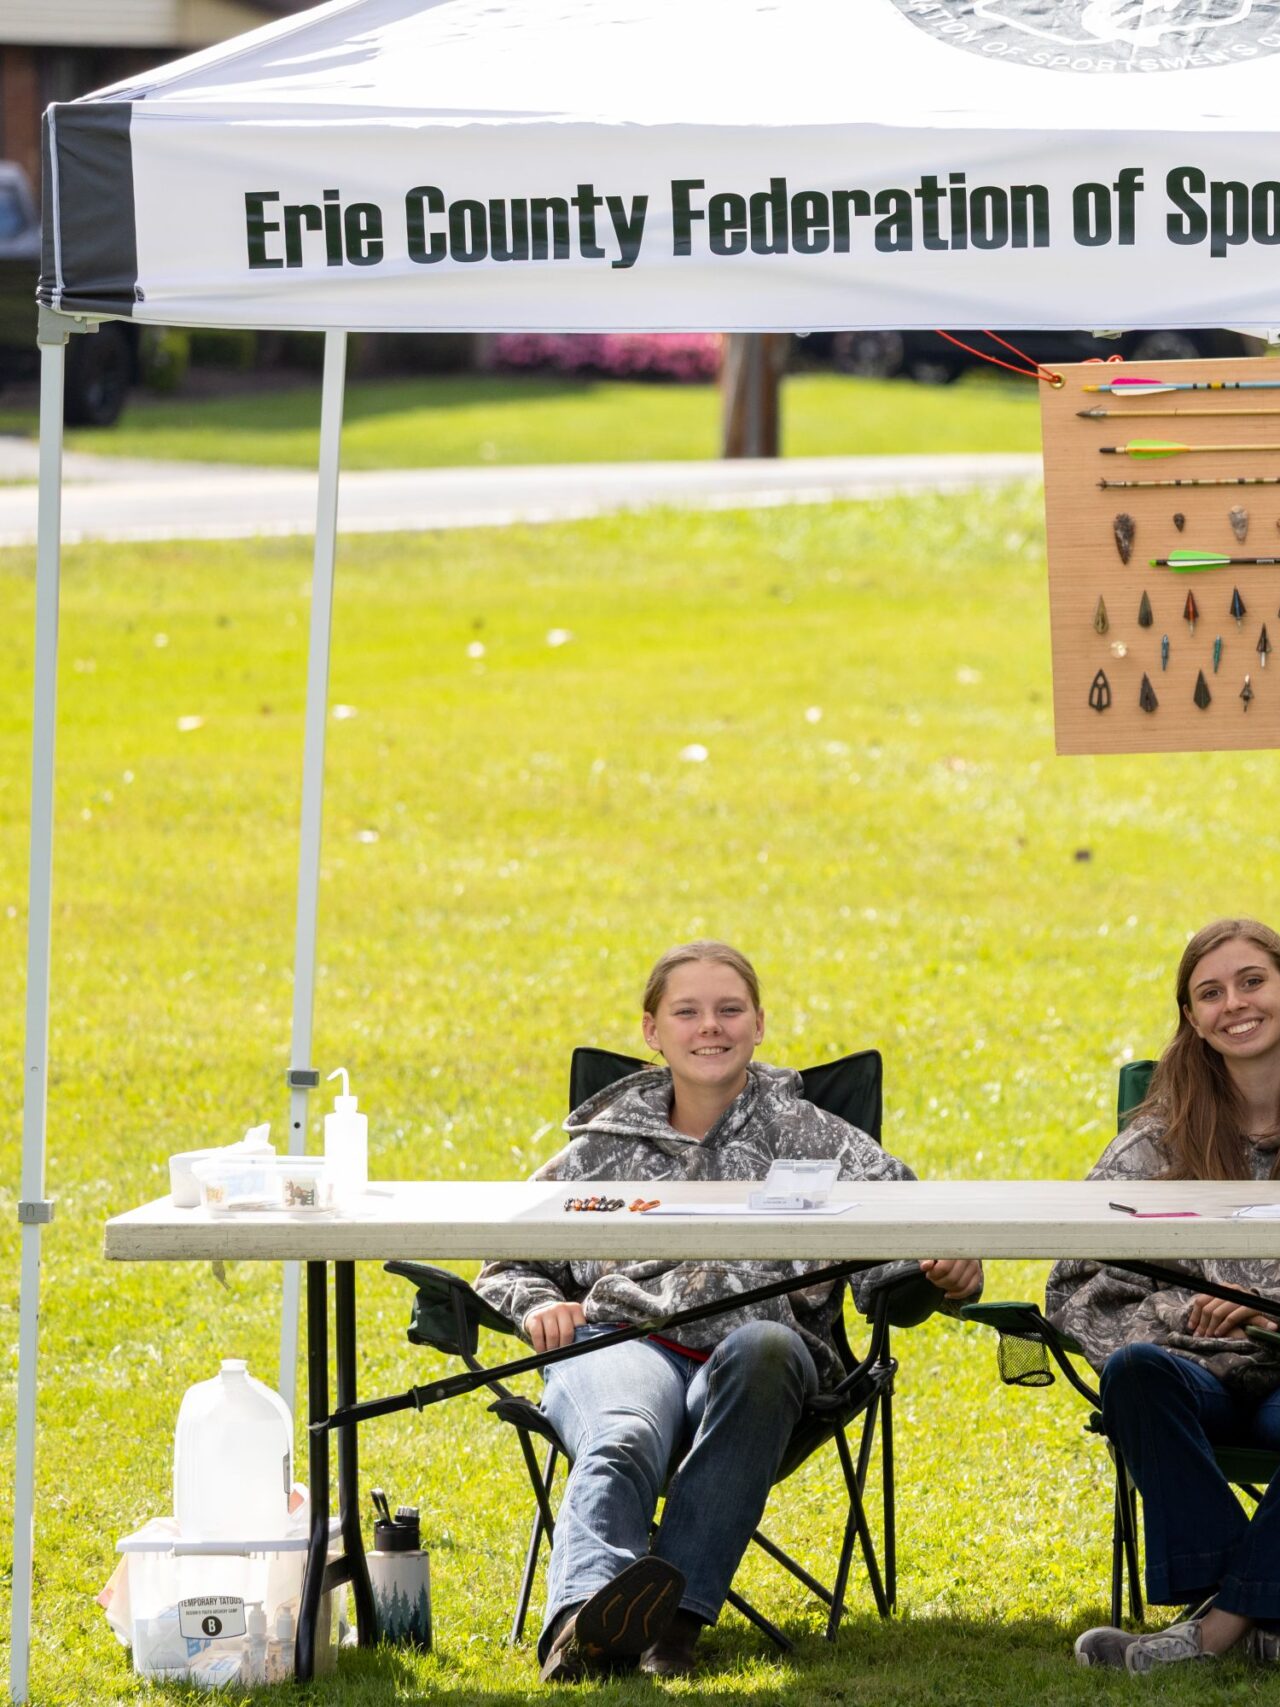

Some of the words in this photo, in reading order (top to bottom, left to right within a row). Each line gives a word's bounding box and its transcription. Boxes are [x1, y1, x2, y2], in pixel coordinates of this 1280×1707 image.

[982, 41, 1027, 56] OF
[1027, 43, 1259, 73] SPORTSMEN'S
[244, 189, 384, 269] Erie
[404, 184, 649, 270] County
[671, 172, 1051, 256] Federation
[1072, 165, 1144, 248] of
[181, 1598, 218, 1607] TEMPORARY
[208, 1618, 216, 1633] B
